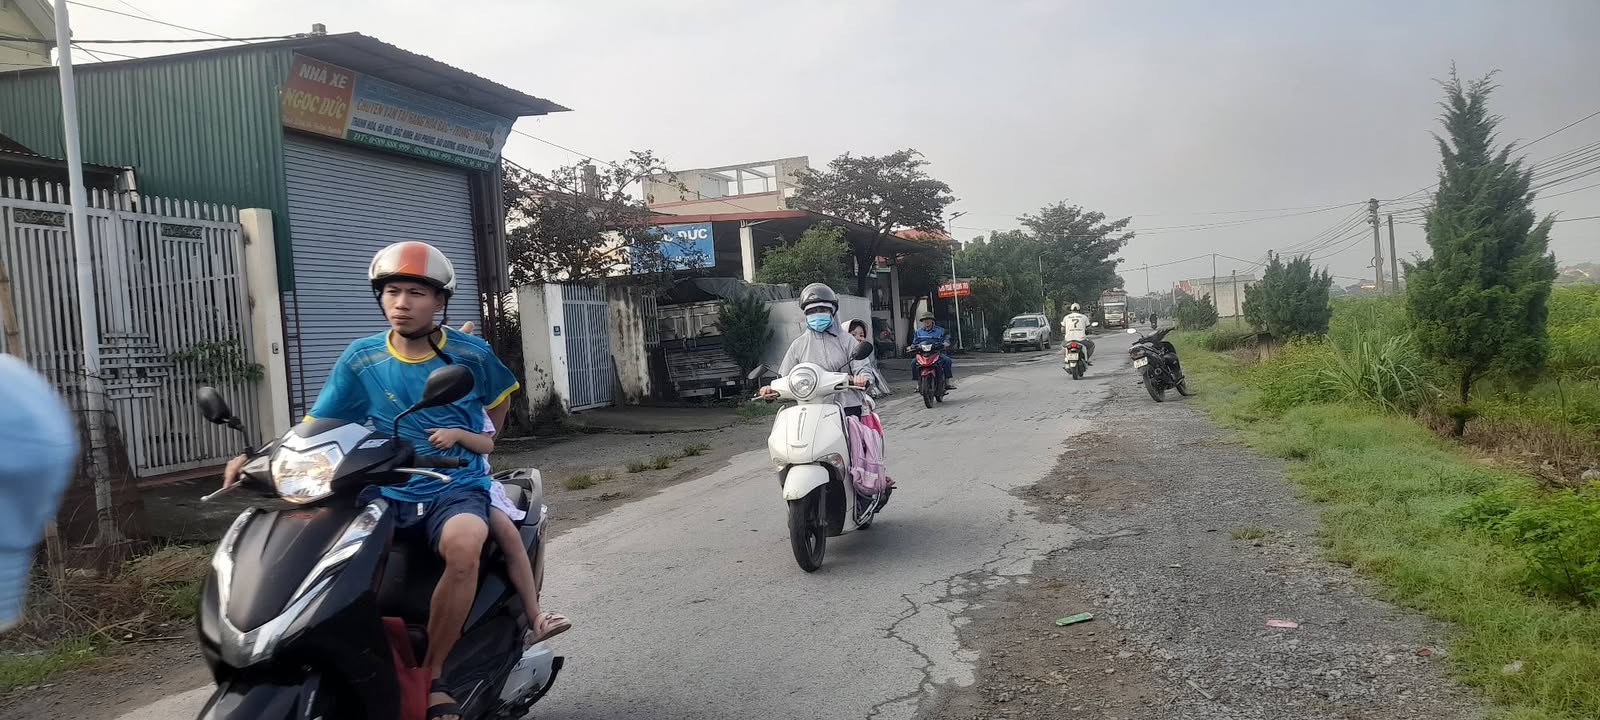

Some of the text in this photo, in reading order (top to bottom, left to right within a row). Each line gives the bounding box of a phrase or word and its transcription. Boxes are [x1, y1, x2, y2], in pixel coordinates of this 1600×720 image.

[300, 63, 349, 89] NHÀ XE
[282, 88, 320, 117] NGỌC
